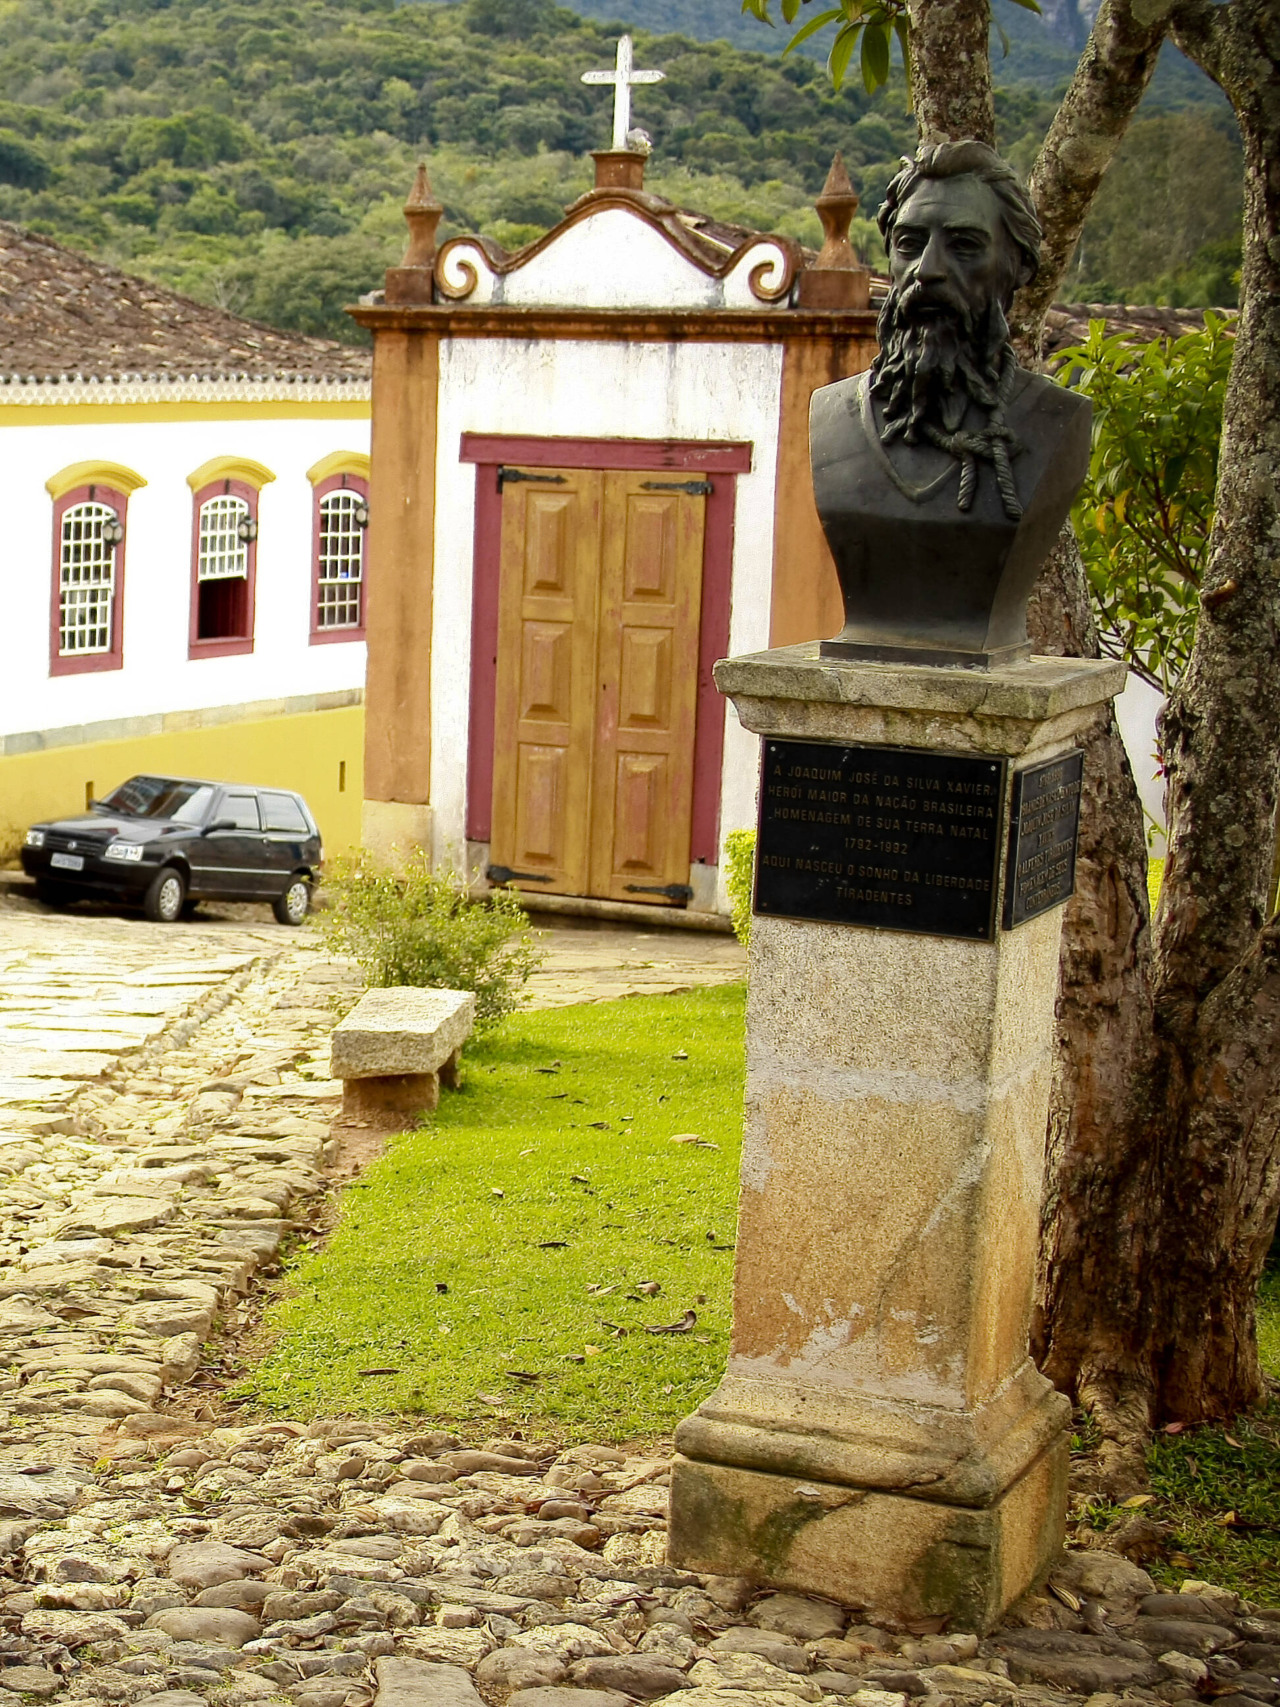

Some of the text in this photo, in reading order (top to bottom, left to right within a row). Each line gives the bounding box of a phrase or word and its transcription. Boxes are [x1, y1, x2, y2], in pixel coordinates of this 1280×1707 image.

[773, 764, 782, 776] A
[787, 765, 842, 781] JOAQUIM
[848, 770, 878, 785] JOSÉ
[883, 774, 899, 787] DA
[906, 776, 940, 791] SILVA
[807, 788, 847, 803] MAIOR
[852, 793, 870, 806] DA
[922, 800, 994, 819] BRASILEIRA
[774, 807, 989, 840] HOMENAGEM DE SUA TERRA NATAL
[762, 855, 991, 892] AQUI NASCEU O SONHO DA LIBERDADE
[836, 886, 912, 906] TIRADENTES
